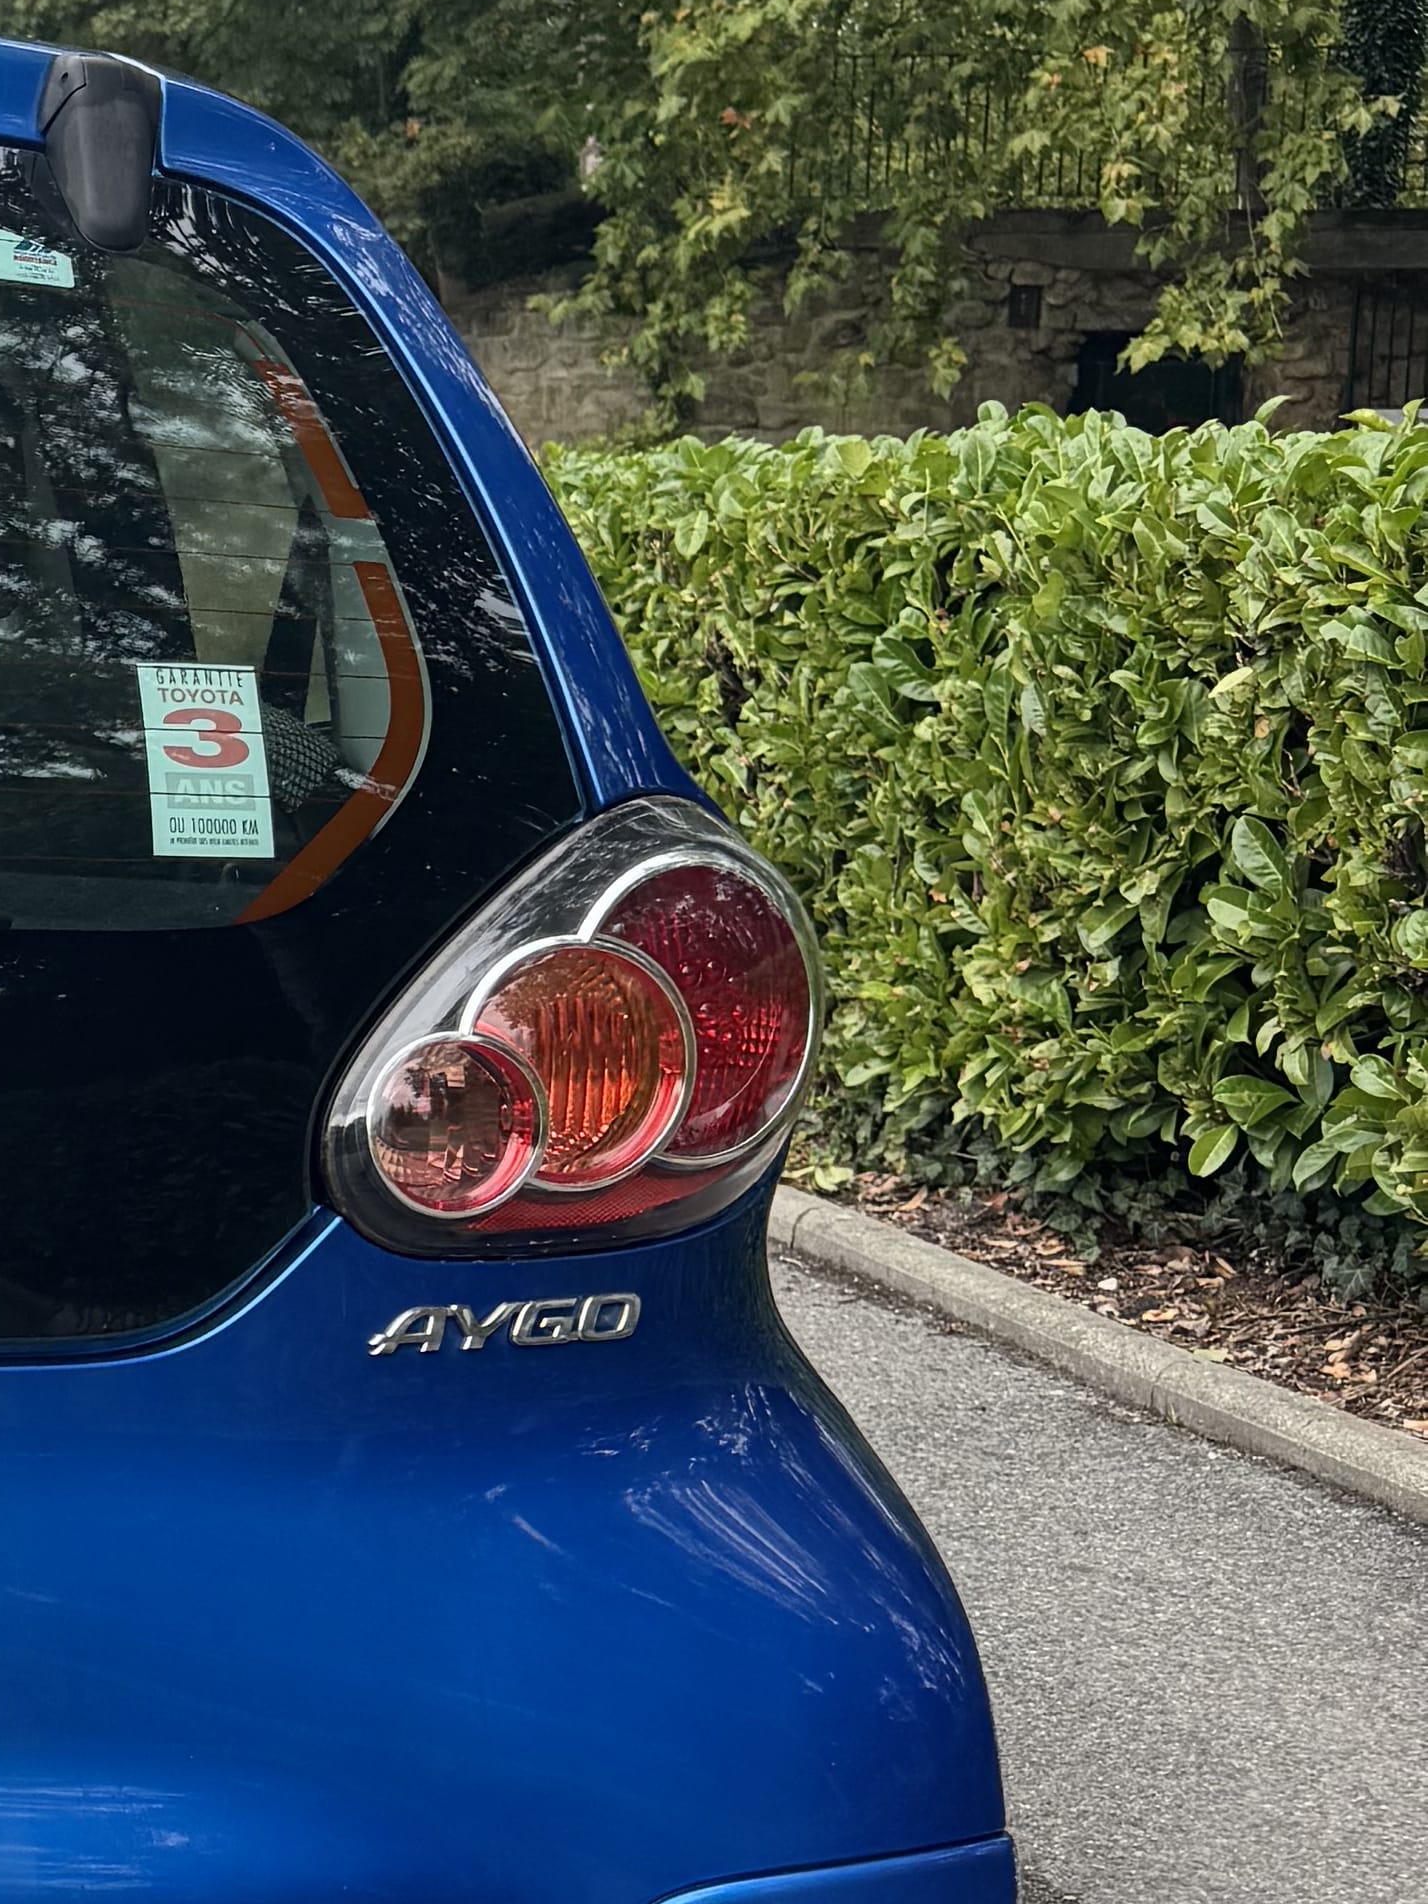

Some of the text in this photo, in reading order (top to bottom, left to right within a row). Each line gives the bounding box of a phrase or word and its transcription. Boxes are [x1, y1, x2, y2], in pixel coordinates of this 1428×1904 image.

[156, 668, 243, 687] GARANTIE
[157, 687, 244, 706] TOYOTA
[163, 707, 249, 768] 3
[174, 779, 248, 805] ANS
[169, 817, 260, 835] OU 100000 KM
[368, 1293, 641, 1356] AYGO
